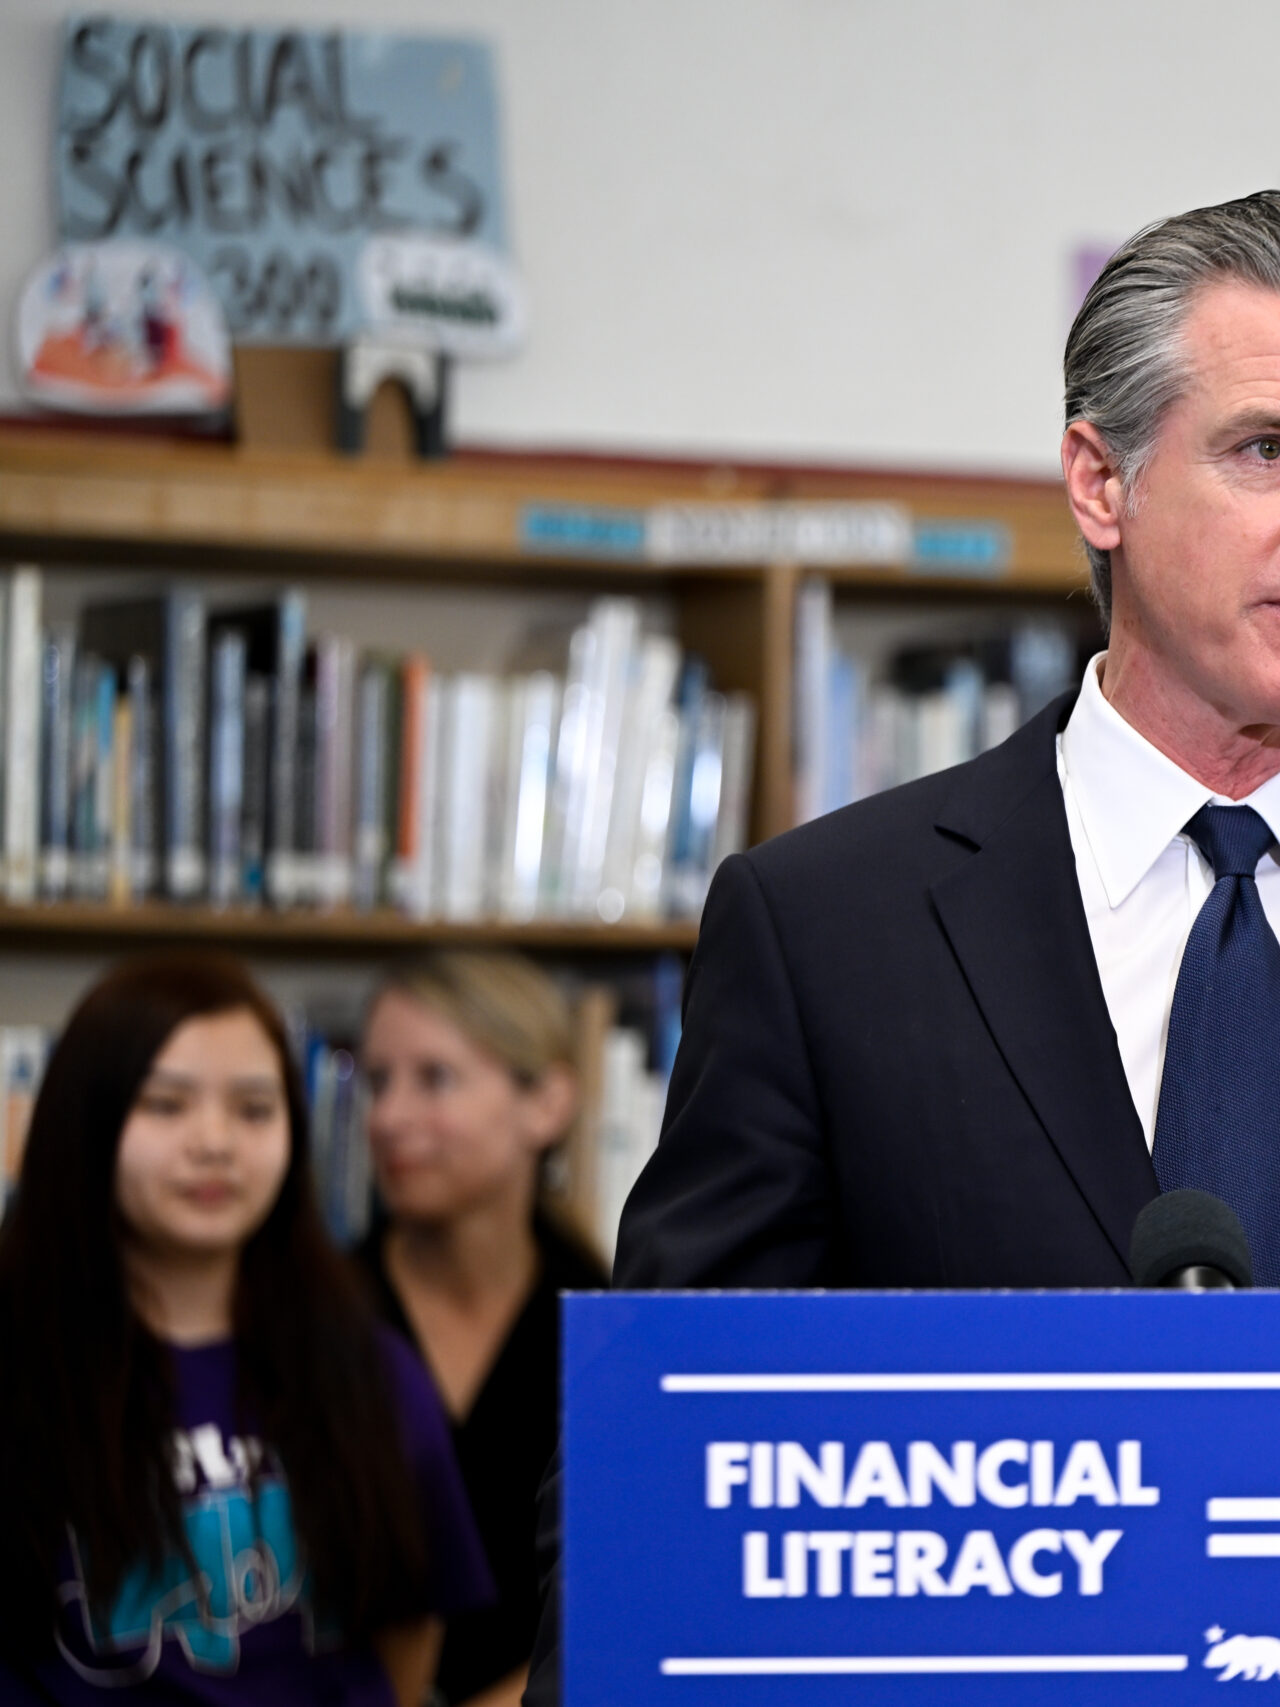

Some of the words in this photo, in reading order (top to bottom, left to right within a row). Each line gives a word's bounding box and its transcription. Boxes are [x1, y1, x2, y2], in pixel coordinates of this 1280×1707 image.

[62, 18, 380, 137] SOCIAL
[60, 126, 486, 240] SCIENCES
[706, 1439, 1160, 1509] FINANCIAL
[743, 1528, 1123, 1598] LITERACY
